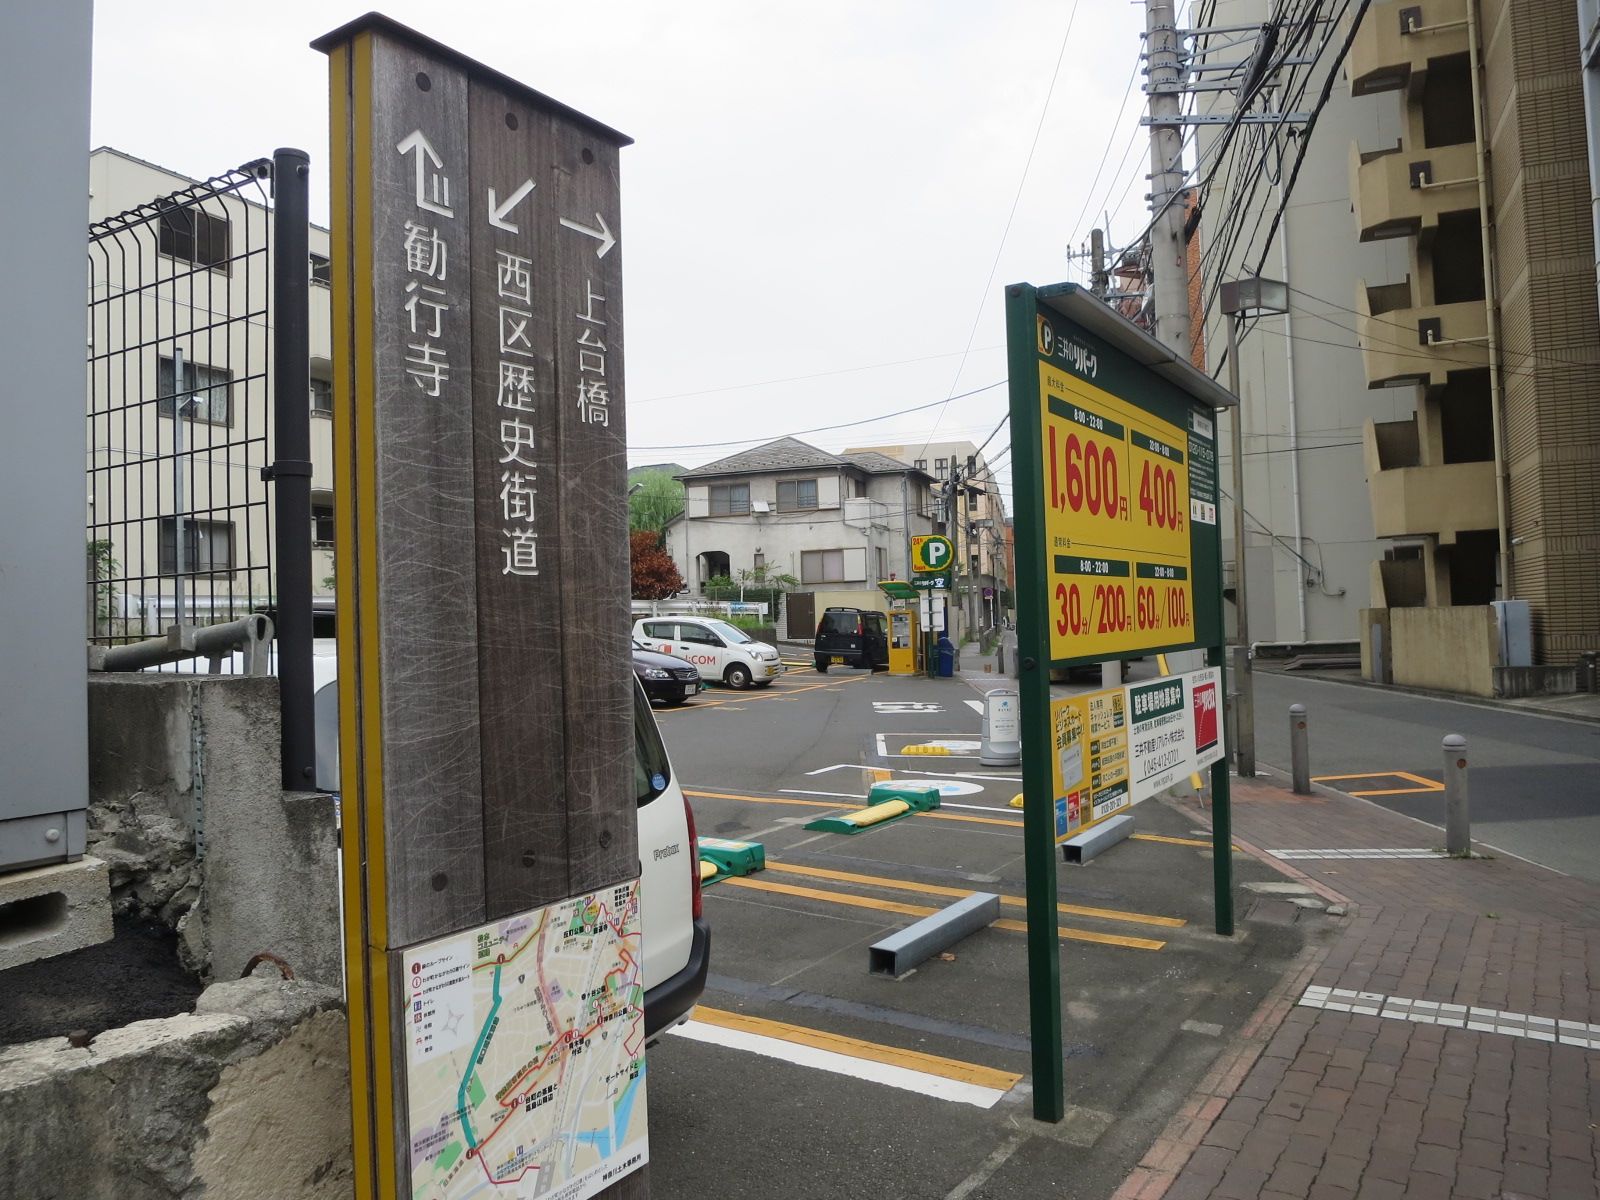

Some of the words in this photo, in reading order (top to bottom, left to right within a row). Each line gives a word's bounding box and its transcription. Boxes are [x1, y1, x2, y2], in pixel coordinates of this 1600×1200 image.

[403, 218, 450, 399] 勧行寺
[575, 279, 611, 429] 上台橋
[1057, 335, 1097, 378] 三井のリパーク
[496, 247, 540, 578] 西区歴史街道
[929, 542, 946, 565] P
[935, 577, 945, 588] 空
[1054, 705, 1070, 721] リパーク
[1134, 684, 1181, 716] 駐車場用地募集中
[1055, 711, 1082, 734] ビジネスカード
[653, 844, 680, 862] Probox
[525, 1083, 558, 1104] 台町の茶屋と
[602, 1153, 642, 1182] 神奈川土木事務所
